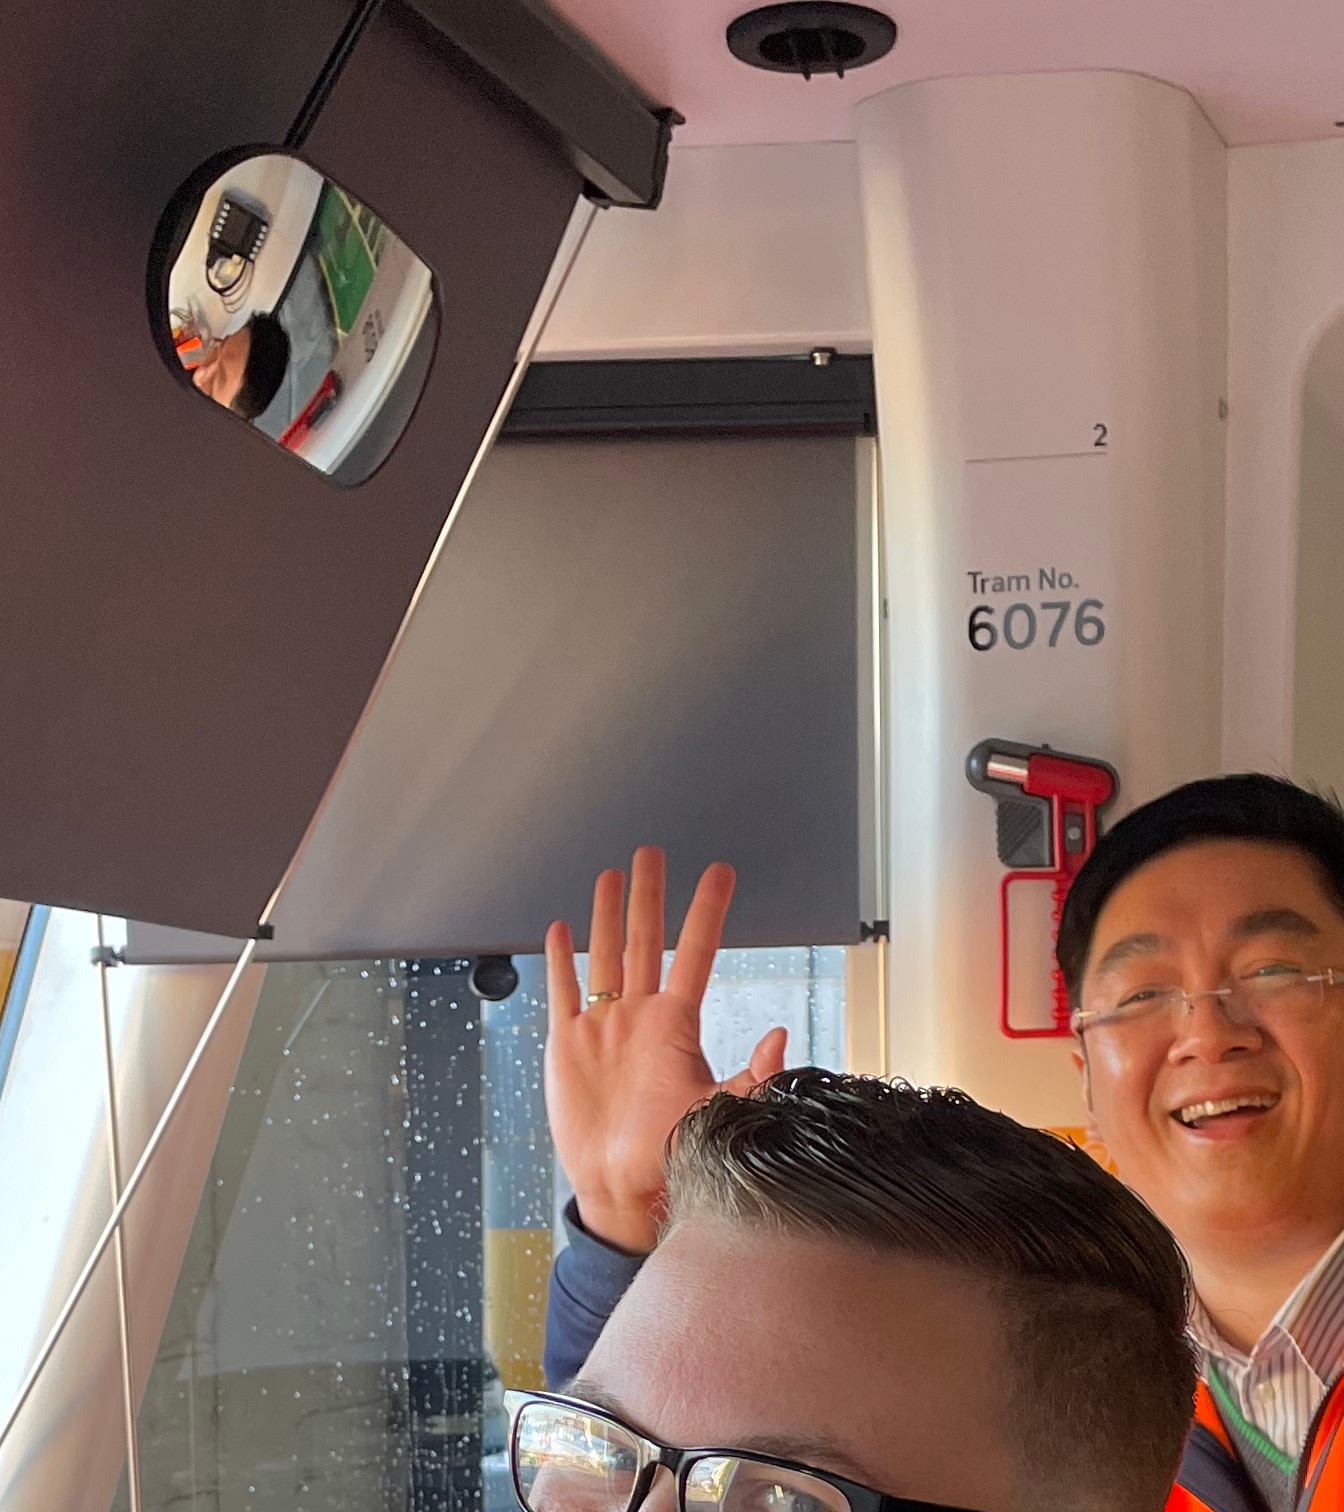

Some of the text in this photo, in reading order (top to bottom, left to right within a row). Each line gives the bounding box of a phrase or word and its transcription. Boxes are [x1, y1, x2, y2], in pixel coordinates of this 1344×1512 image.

[1092, 422, 1109, 448] 2
[967, 566, 1081, 596] Tram No.
[966, 598, 1107, 652] 6076
